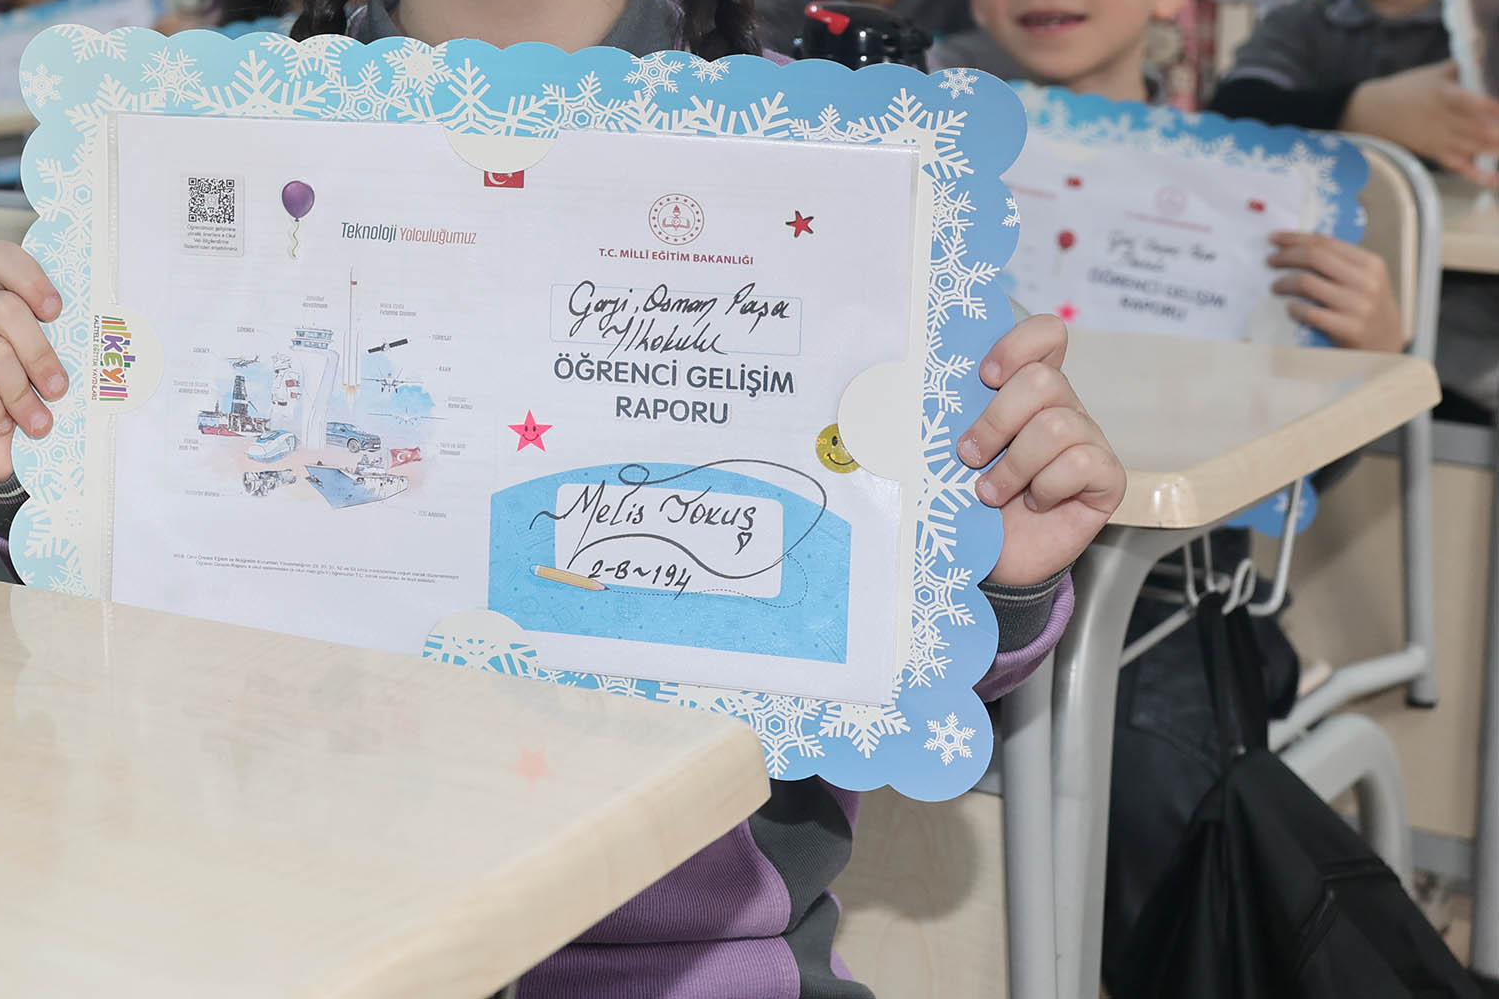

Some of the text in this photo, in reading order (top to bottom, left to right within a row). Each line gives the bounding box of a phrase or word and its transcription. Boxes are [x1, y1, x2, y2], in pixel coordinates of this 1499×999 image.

[341, 222, 477, 245] Teknoloji Yolculuğumuz
[599, 248, 754, 265] T.C. MİLLİ EĞİTİM BAKANLIĞI
[102, 334, 124, 384] KEY
[553, 352, 795, 397] ÖĞRENCİ GELİŞİM
[615, 396, 729, 424] RAPORU
